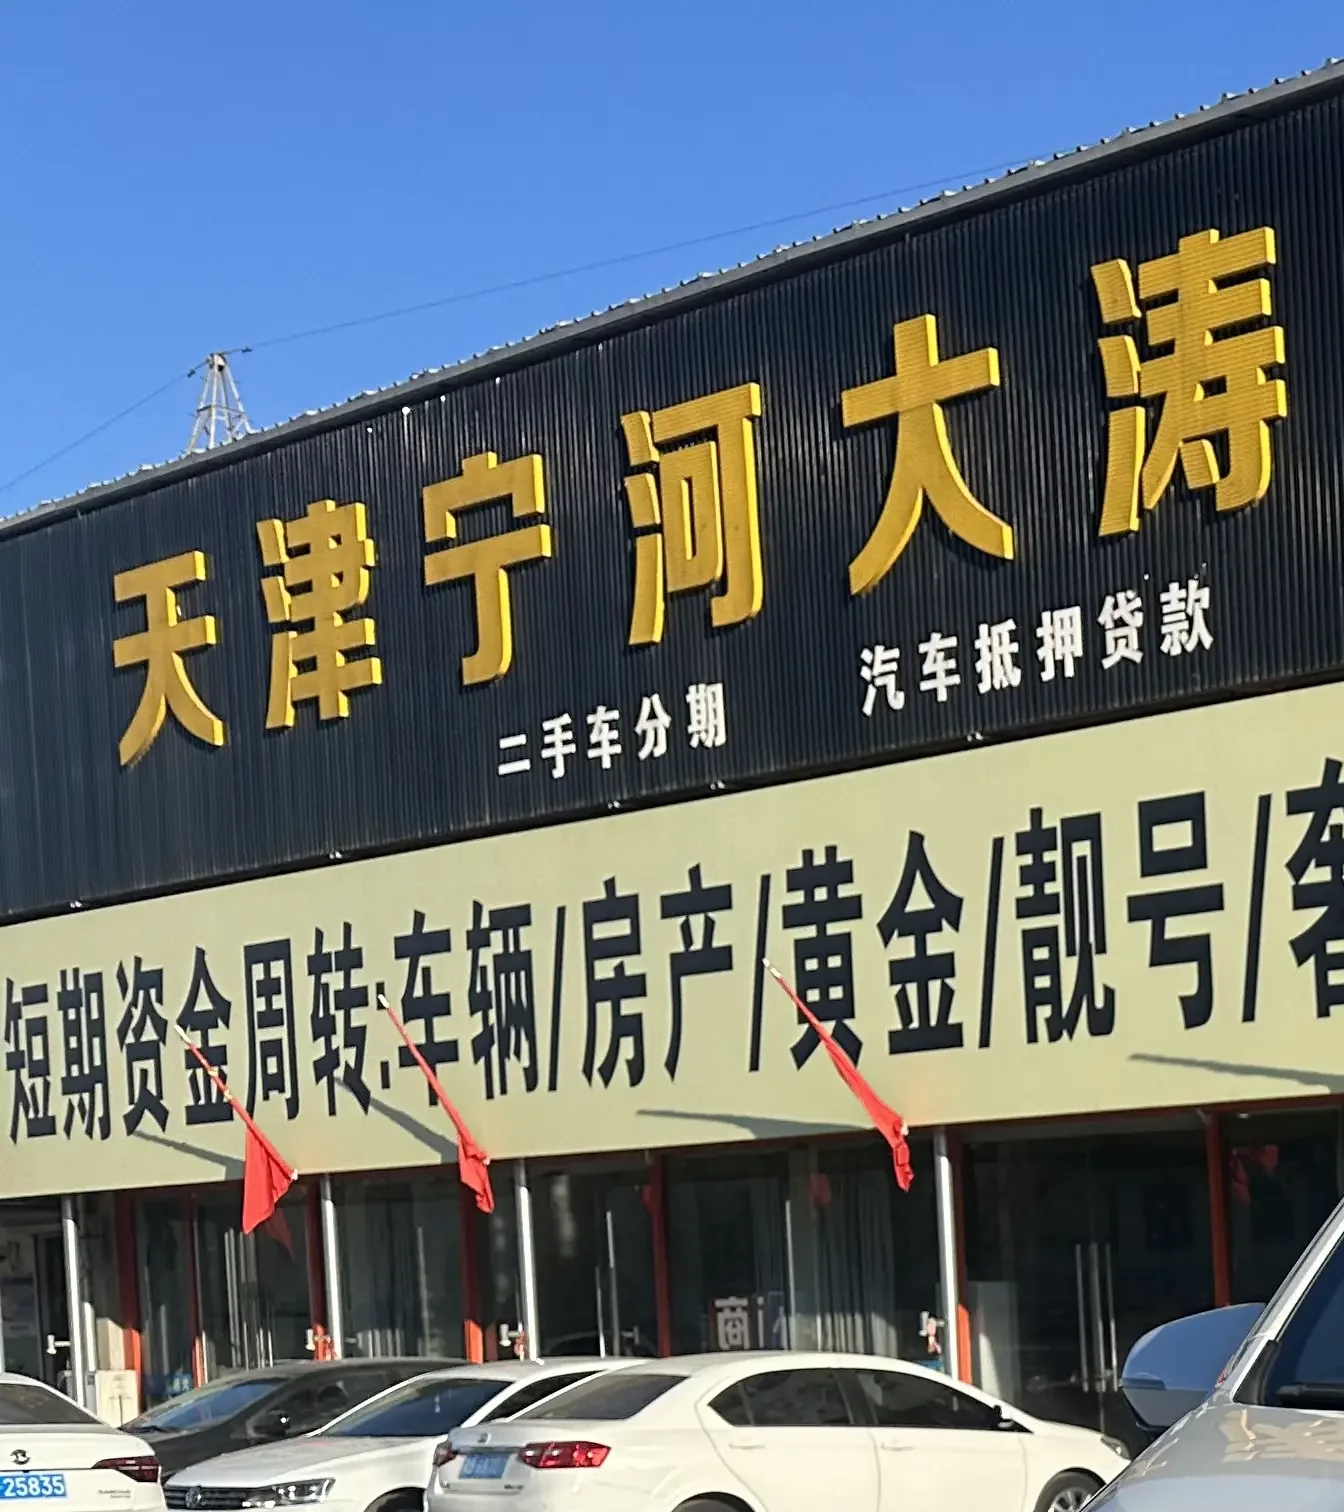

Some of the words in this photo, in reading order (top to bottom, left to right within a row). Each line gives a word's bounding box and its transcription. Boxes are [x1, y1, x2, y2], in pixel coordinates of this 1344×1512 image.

[497, 682, 726, 780] 二手车分期
[859, 578, 1213, 718] 汽车抵押贷款
[2, 1476, 65, 1497] 25835
